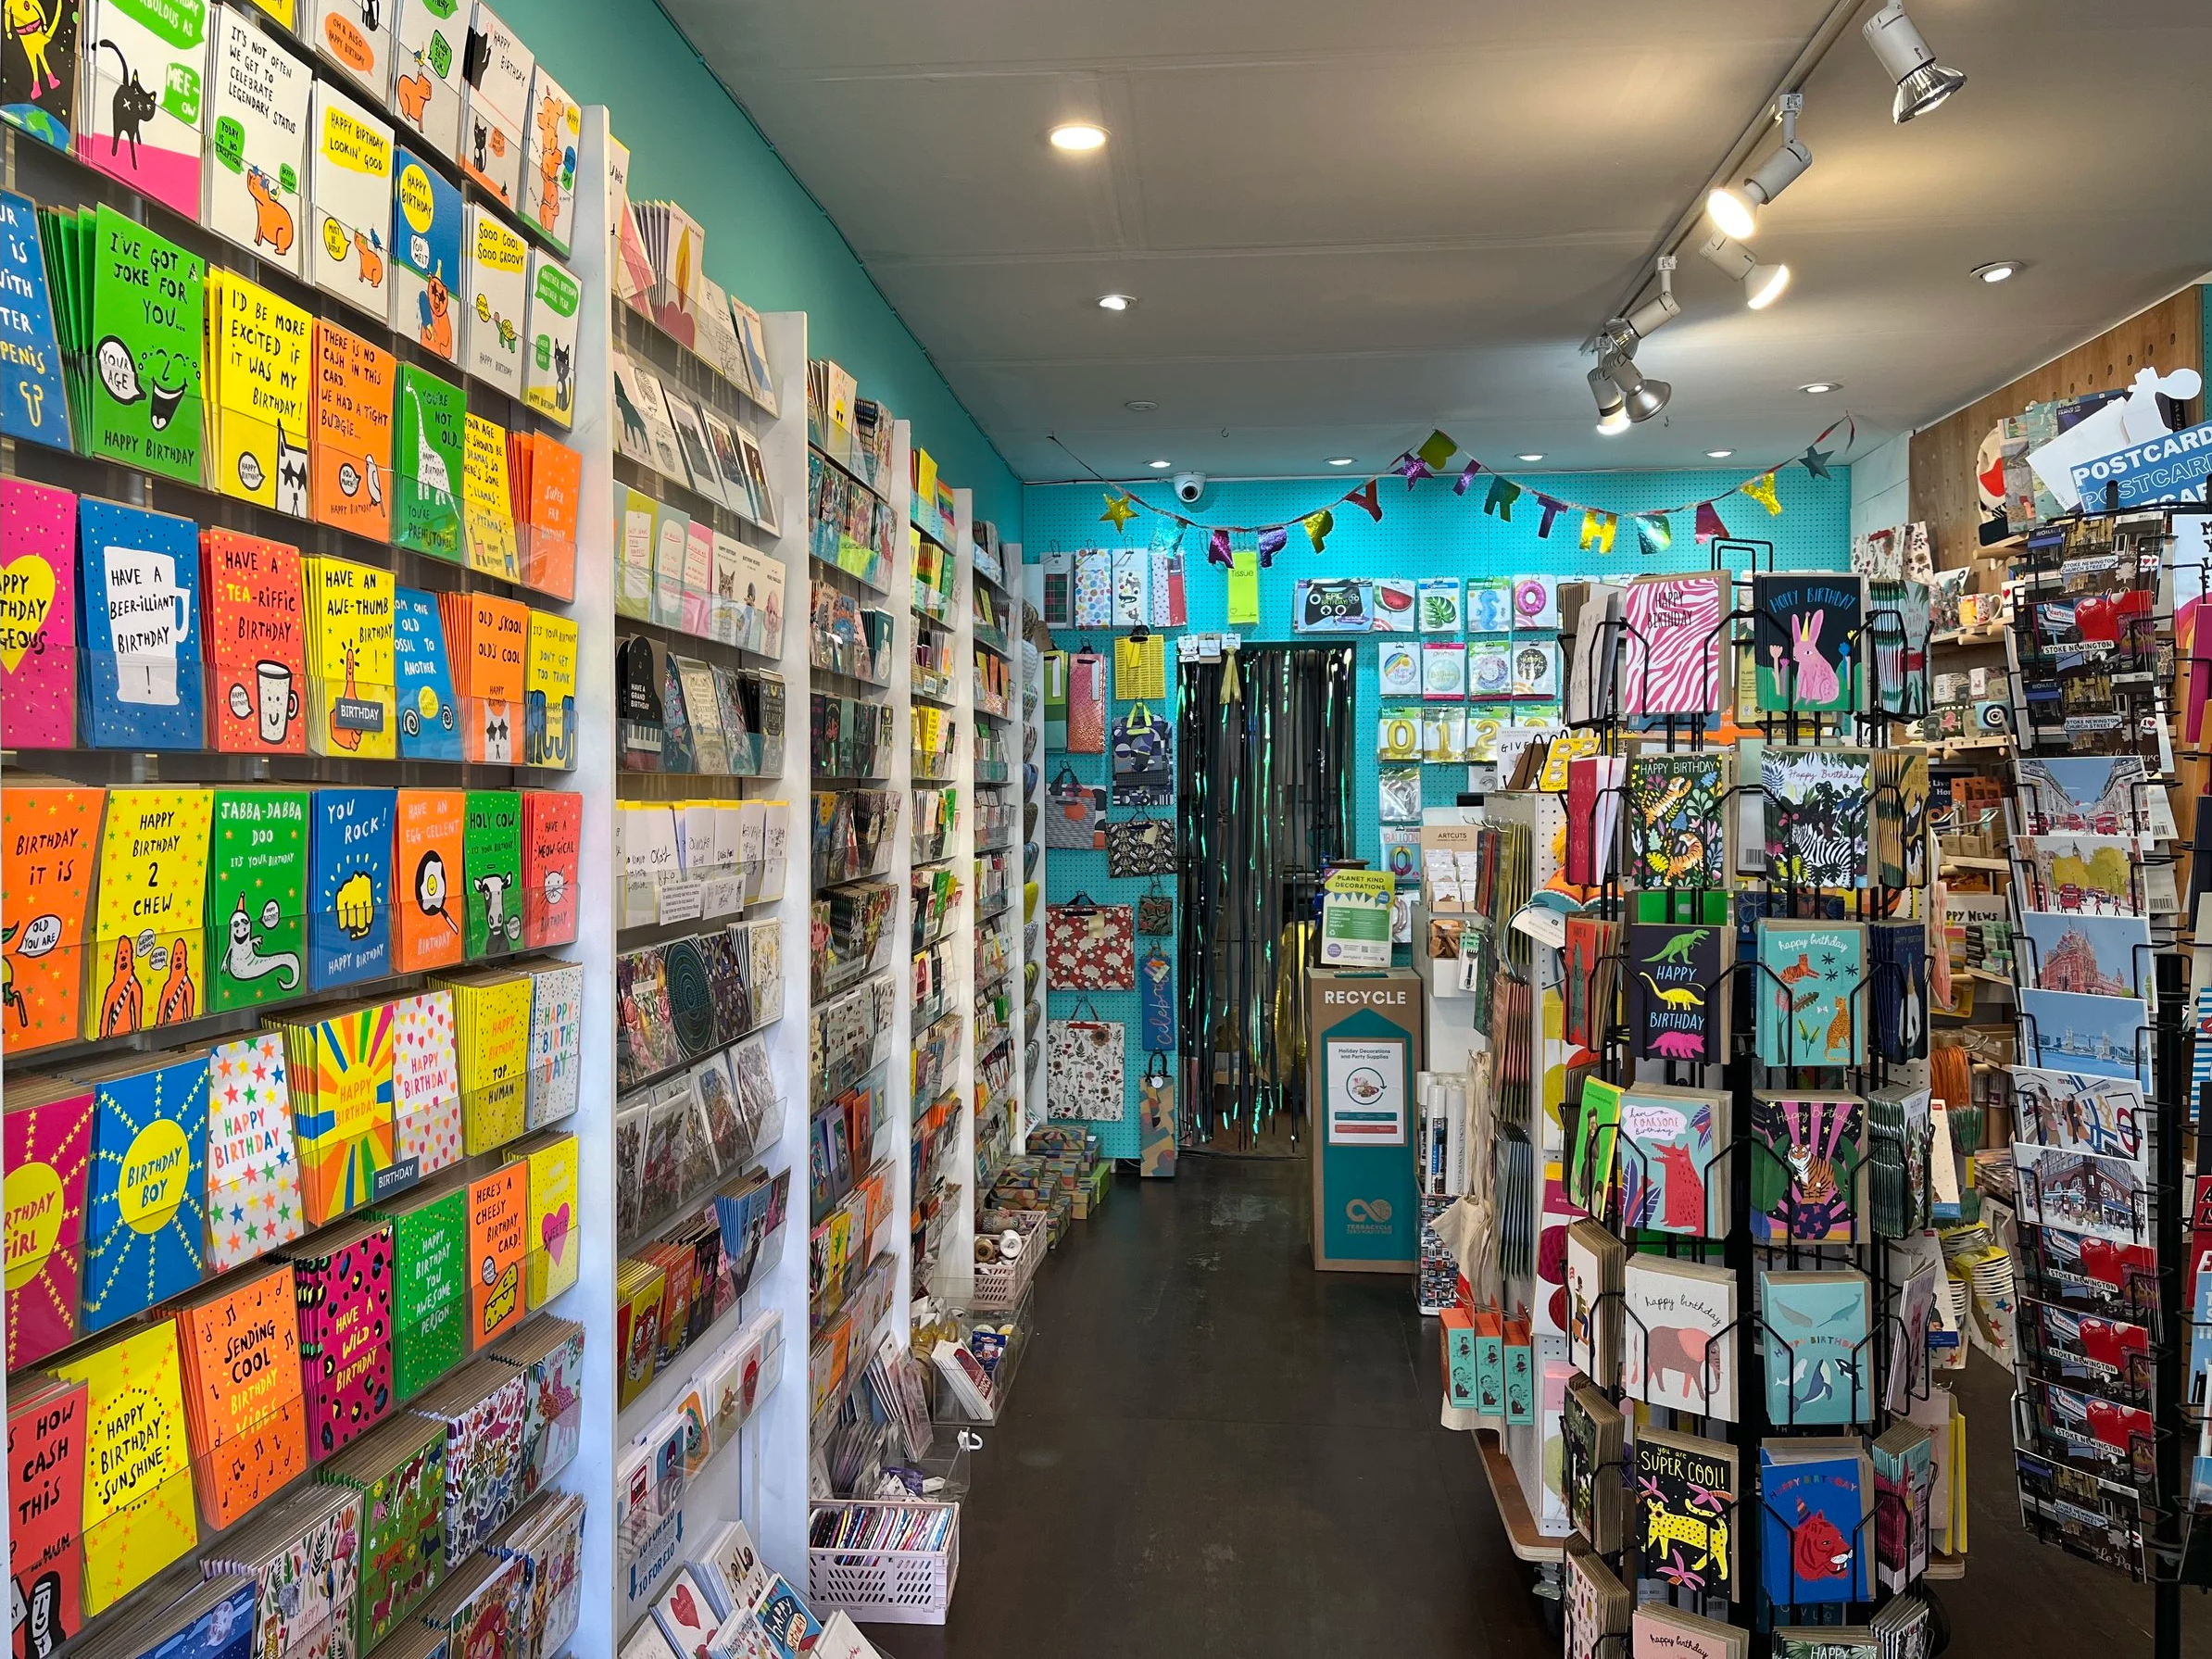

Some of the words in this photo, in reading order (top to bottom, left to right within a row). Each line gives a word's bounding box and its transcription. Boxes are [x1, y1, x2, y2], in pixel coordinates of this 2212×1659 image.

[230, 44, 241, 64] WE
[244, 57, 259, 74] GET
[265, 69, 273, 83] TO
[232, 26, 246, 46] IT'S
[251, 43, 266, 57] NOT
[271, 57, 292, 78] OFTEN
[501, 56, 526, 86] BIRTHDAY
[331, 112, 353, 135] HAPPY
[357, 127, 384, 152] BIRTHDAY
[402, 187, 433, 220] BIRTHDAY
[114, 263, 149, 286] JOKE
[160, 278, 186, 304] FOR
[233, 290, 246, 311] I'D
[256, 303, 267, 320] BE
[276, 313, 305, 335] MORE
[101, 349, 130, 371] YOUR
[107, 371, 128, 390] AGE
[434, 411, 452, 427] NOT
[105, 429, 138, 454] HAPPY
[146, 439, 195, 462] BIRTHDAY
[491, 460, 498, 471] SO
[226, 550, 258, 571] HAVE
[271, 558, 278, 574] A
[112, 569, 143, 586] HAVE
[154, 567, 162, 582] A
[326, 571, 354, 588] HAVE
[364, 573, 376, 588] AN
[1655, 591, 1683, 609] HAPPY
[1807, 586, 1856, 610] BIRTHDAY
[239, 617, 291, 642] BIRTHDAY
[479, 610, 493, 626] OLD
[498, 615, 522, 635] SKOOL
[1647, 610, 1692, 629] BIRTHDAY
[118, 627, 170, 653] BIRTHDAY
[2045, 646, 2067, 654] STOKE
[2068, 641, 2112, 652] NEWINGTON
[631, 683, 640, 693] HAVE
[631, 692, 645, 701] GRAND
[631, 699, 649, 710] BIRTHDAY
[1640, 763, 1668, 774] HAPPY
[1674, 760, 1716, 773] BIRTHDAY
[1789, 769, 1817, 780] Happy
[221, 801, 302, 821] JABBA-DABBA
[328, 798, 355, 823] YOU
[471, 811, 491, 829] HOLY
[496, 811, 515, 826] COW
[16, 828, 79, 856] BIRTHDAY
[252, 830, 273, 846] DOO
[1386, 834, 1419, 843] BALLOON
[1335, 882, 1386, 890] DECORATIONS
[33, 920, 49, 932] OLD
[1968, 911, 1998, 922] NEWS
[24, 936, 39, 950] YOU
[42, 933, 56, 946] ARE
[417, 933, 451, 955] BIRTHDAY
[1778, 937, 1808, 951] happy
[1810, 933, 1848, 953] birthday
[1656, 965, 1697, 982] HAPPY
[1325, 990, 1406, 1005] RECYCLE
[492, 1015, 515, 1036] HAPPY
[1650, 1012, 1705, 1030] BIRTHDAY
[225, 1107, 264, 1137] HAPPY
[1776, 1107, 1810, 1125] Happy
[1811, 1106, 1855, 1132] Birthday
[215, 1127, 279, 1168] BIRTHDAY
[127, 1147, 182, 1188] BIRTHDAY
[378, 1164, 413, 1188] BIRTHDAY
[141, 1178, 168, 1209] BOY
[476, 1200, 506, 1225] CHEESY
[2051, 1270, 2072, 1280] STOKE
[2074, 1276, 2117, 1291] NEWINGTON
[1645, 1296, 1675, 1311] happy
[1680, 1295, 1722, 1326] birthday
[233, 1351, 270, 1384] COOL
[336, 1345, 377, 1393] BIRTHDAY
[2051, 1349, 2072, 1360] STOKE
[2074, 1355, 2117, 1372] NEWINGTON
[36, 1400, 74, 1442] HOW
[465, 1433, 491, 1464] HAPPY
[2057, 1428, 2079, 1439] STOKE
[2080, 1436, 2124, 1454] NEWINGTON
[23, 1437, 69, 1483] CASH
[1640, 1451, 1684, 1479] SUPER
[1675, 1451, 1687, 1459] are
[639, 1580, 647, 1597] 10
[648, 1563, 661, 1586] FOR
[662, 1542, 674, 1566] £10
[1650, 1633, 1675, 1649] happy
[1676, 1635, 1709, 1659] birthday
[1811, 1645, 1851, 1659] HAPPY
